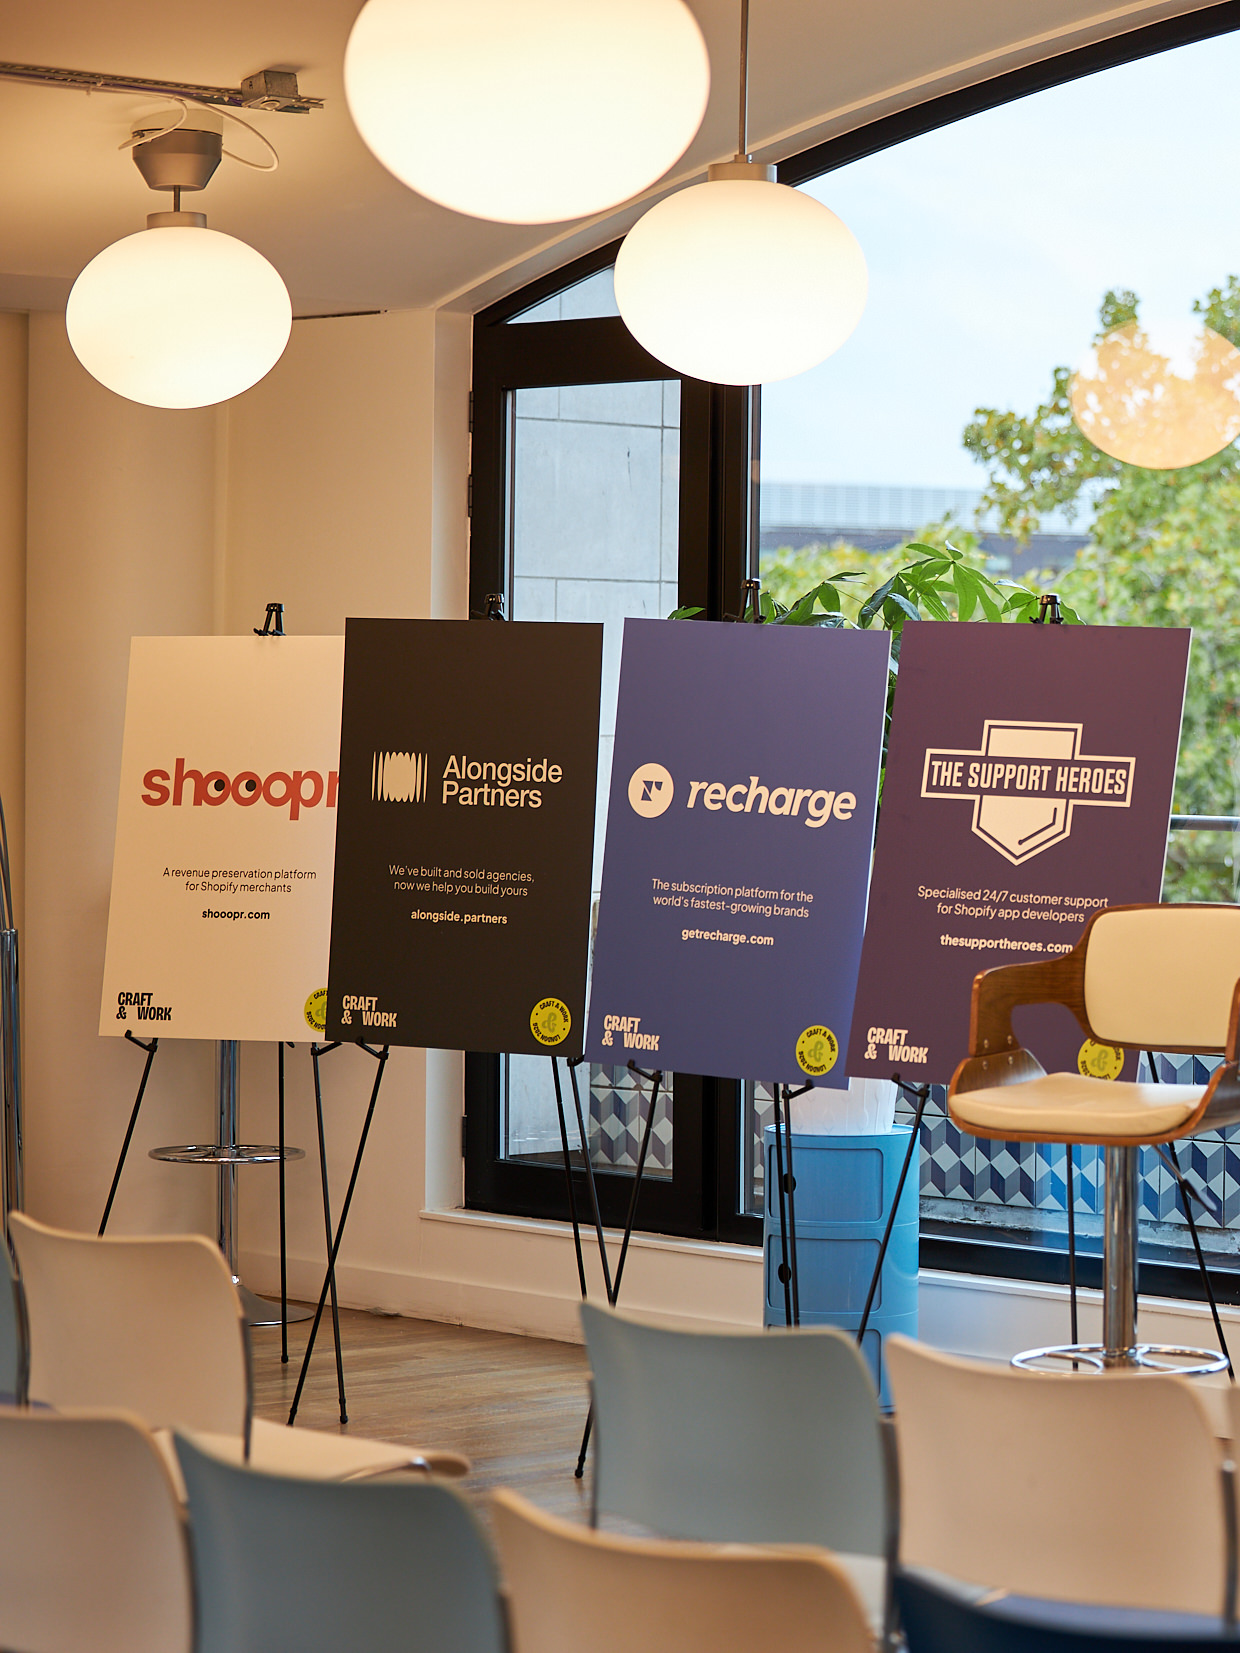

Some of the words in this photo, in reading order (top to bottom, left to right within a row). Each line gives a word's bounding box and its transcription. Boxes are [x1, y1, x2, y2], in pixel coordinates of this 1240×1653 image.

[442, 755, 563, 787] Alongside
[931, 761, 964, 787] THE
[968, 763, 1052, 791] SUPPORT
[1055, 766, 1127, 795] HEROES
[442, 780, 542, 808] Partners
[687, 776, 857, 828] recharge
[163, 867, 170, 877] A
[171, 869, 210, 878] revenue
[212, 869, 273, 880] preservation
[274, 869, 317, 881] platform
[389, 865, 419, 876] We've
[420, 866, 442, 878] built
[443, 868, 462, 879] and
[463, 869, 485, 880] sold
[487, 871, 535, 883] agencies,
[185, 881, 199, 891] for
[201, 881, 238, 894] Shopify
[240, 882, 292, 893] merchants
[394, 881, 415, 890] now
[416, 882, 430, 892] we
[432, 881, 453, 894] help
[455, 884, 473, 895] you
[475, 884, 499, 895] build
[500, 886, 528, 898] yours
[652, 878, 670, 890] The
[671, 881, 734, 897] subscription
[734, 886, 779, 900] platform
[780, 890, 796, 902] for
[796, 891, 814, 903] the
[917, 885, 981, 901] Specialised
[983, 890, 1009, 902] 24/7
[1010, 892, 1063, 905] customer
[1064, 896, 1109, 909] support
[202, 909, 270, 920] shooopr.com
[653, 896, 689, 908] world's
[690, 898, 772, 917] fastest-growing
[773, 904, 810, 918] brands
[937, 903, 953, 915] for
[954, 904, 997, 920] Shopify
[998, 910, 1020, 921] app
[1022, 910, 1085, 924] developers
[411, 909, 508, 925] alongside.partners
[681, 928, 774, 946] getrecharge.com
[940, 934, 1073, 954] thesupportheroes.com
[117, 992, 153, 1006] CRAFT
[342, 995, 378, 1011] CRAFT
[116, 1006, 127, 1020] &
[137, 1007, 172, 1021] WORK
[341, 1009, 352, 1025] &
[362, 1011, 397, 1027] WORK
[603, 1014, 641, 1033] CRAFT
[601, 1030, 614, 1047] &
[623, 1032, 660, 1051] WORK
[867, 1026, 909, 1046] CRAFT
[864, 1043, 878, 1060] &
[888, 1045, 929, 1064] WORK
